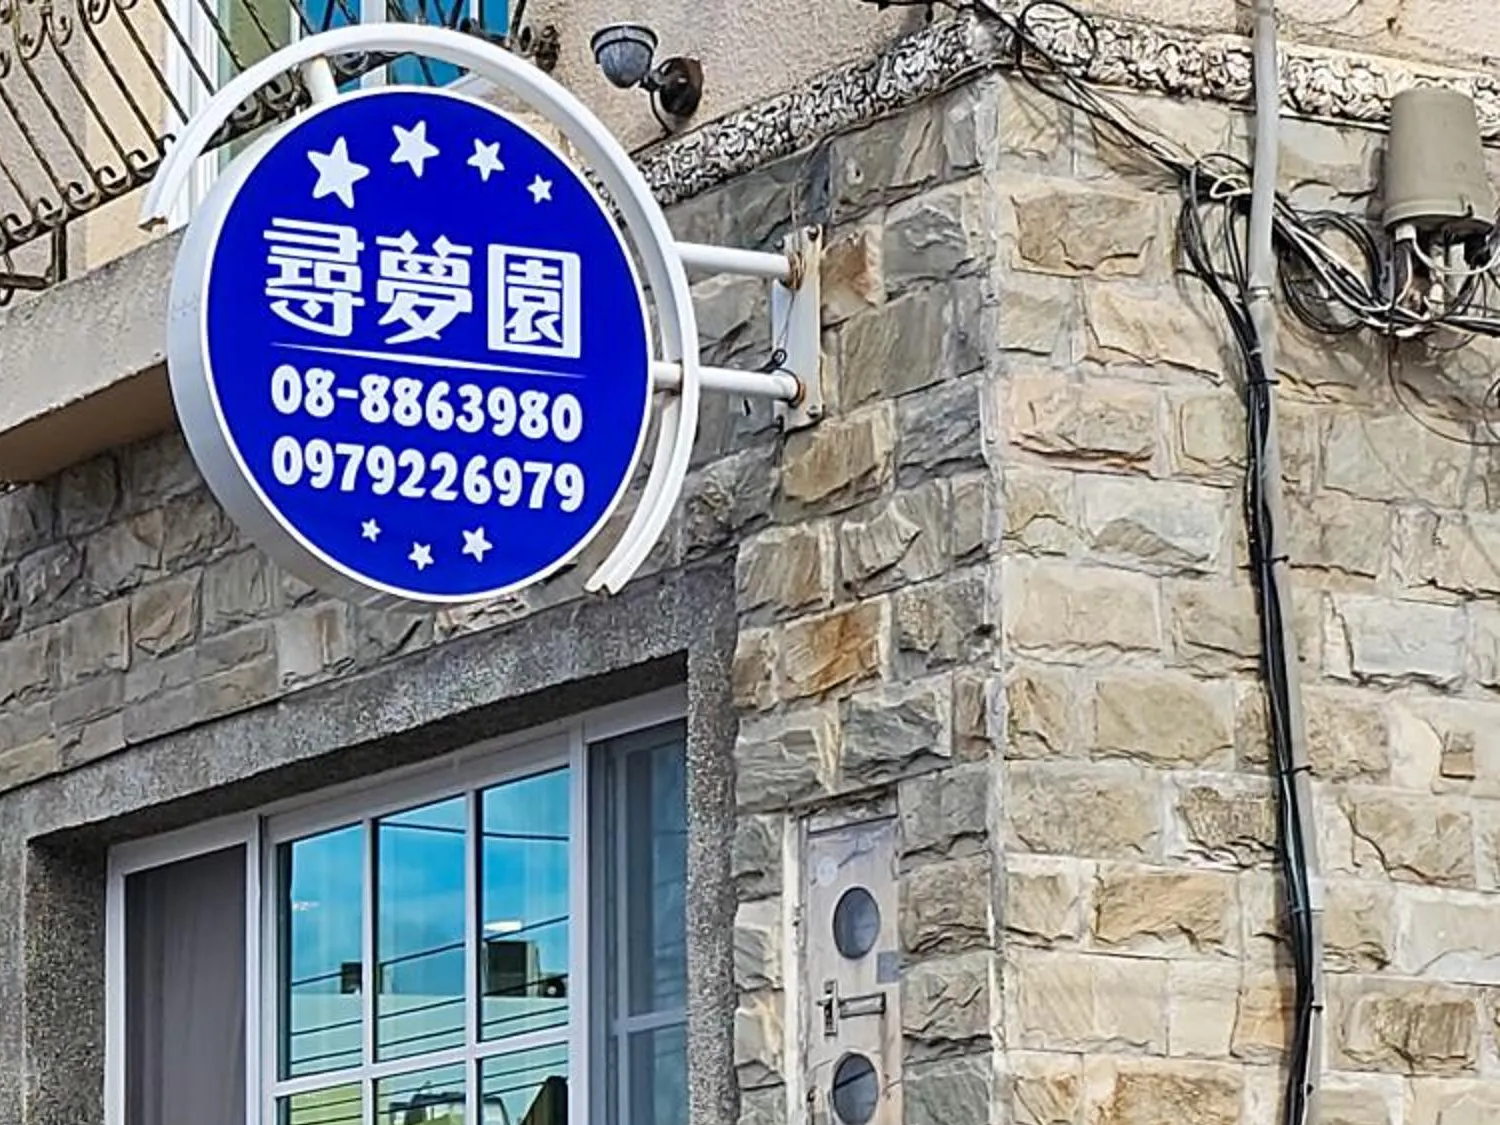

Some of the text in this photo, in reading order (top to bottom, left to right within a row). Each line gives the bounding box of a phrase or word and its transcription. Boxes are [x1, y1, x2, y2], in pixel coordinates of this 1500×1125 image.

[263, 217, 581, 359] 尋夢園
[271, 364, 583, 443] 08-8863980
[271, 435, 585, 513] 0979226979
